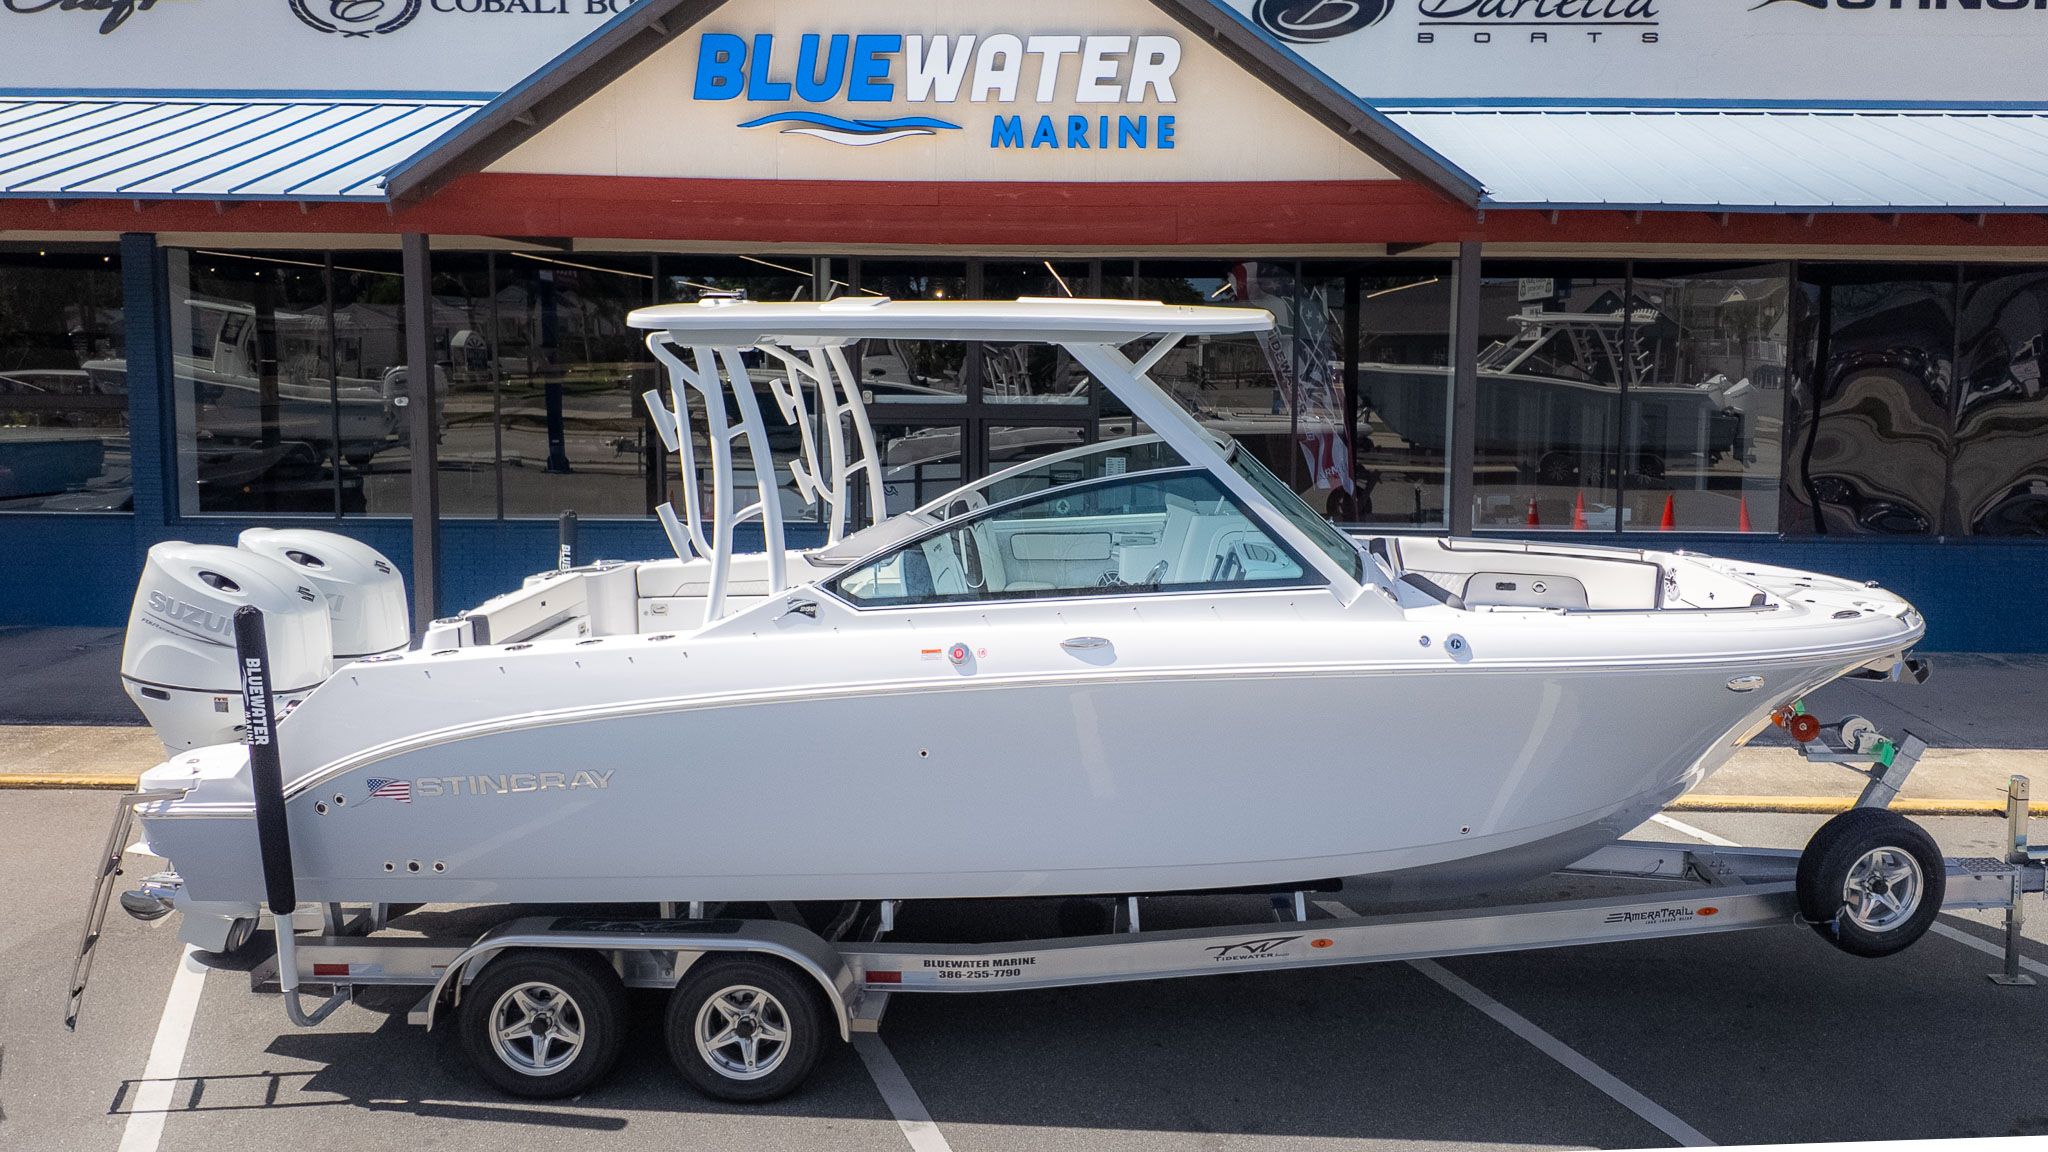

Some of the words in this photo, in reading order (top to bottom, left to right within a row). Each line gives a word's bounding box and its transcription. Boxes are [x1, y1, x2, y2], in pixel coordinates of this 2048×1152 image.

[1417, 32, 1659, 43] BOATS
[693, 33, 1181, 103] BLUEWATER
[990, 115, 1176, 150] MARINE
[148, 589, 234, 636] SUZU
[245, 657, 270, 746] BLUEWATER
[415, 768, 616, 797] STINGRAY
[923, 959, 990, 968] BLUEWATER
[993, 956, 1037, 967] MARINE
[939, 968, 1021, 979] 386-255-7790
